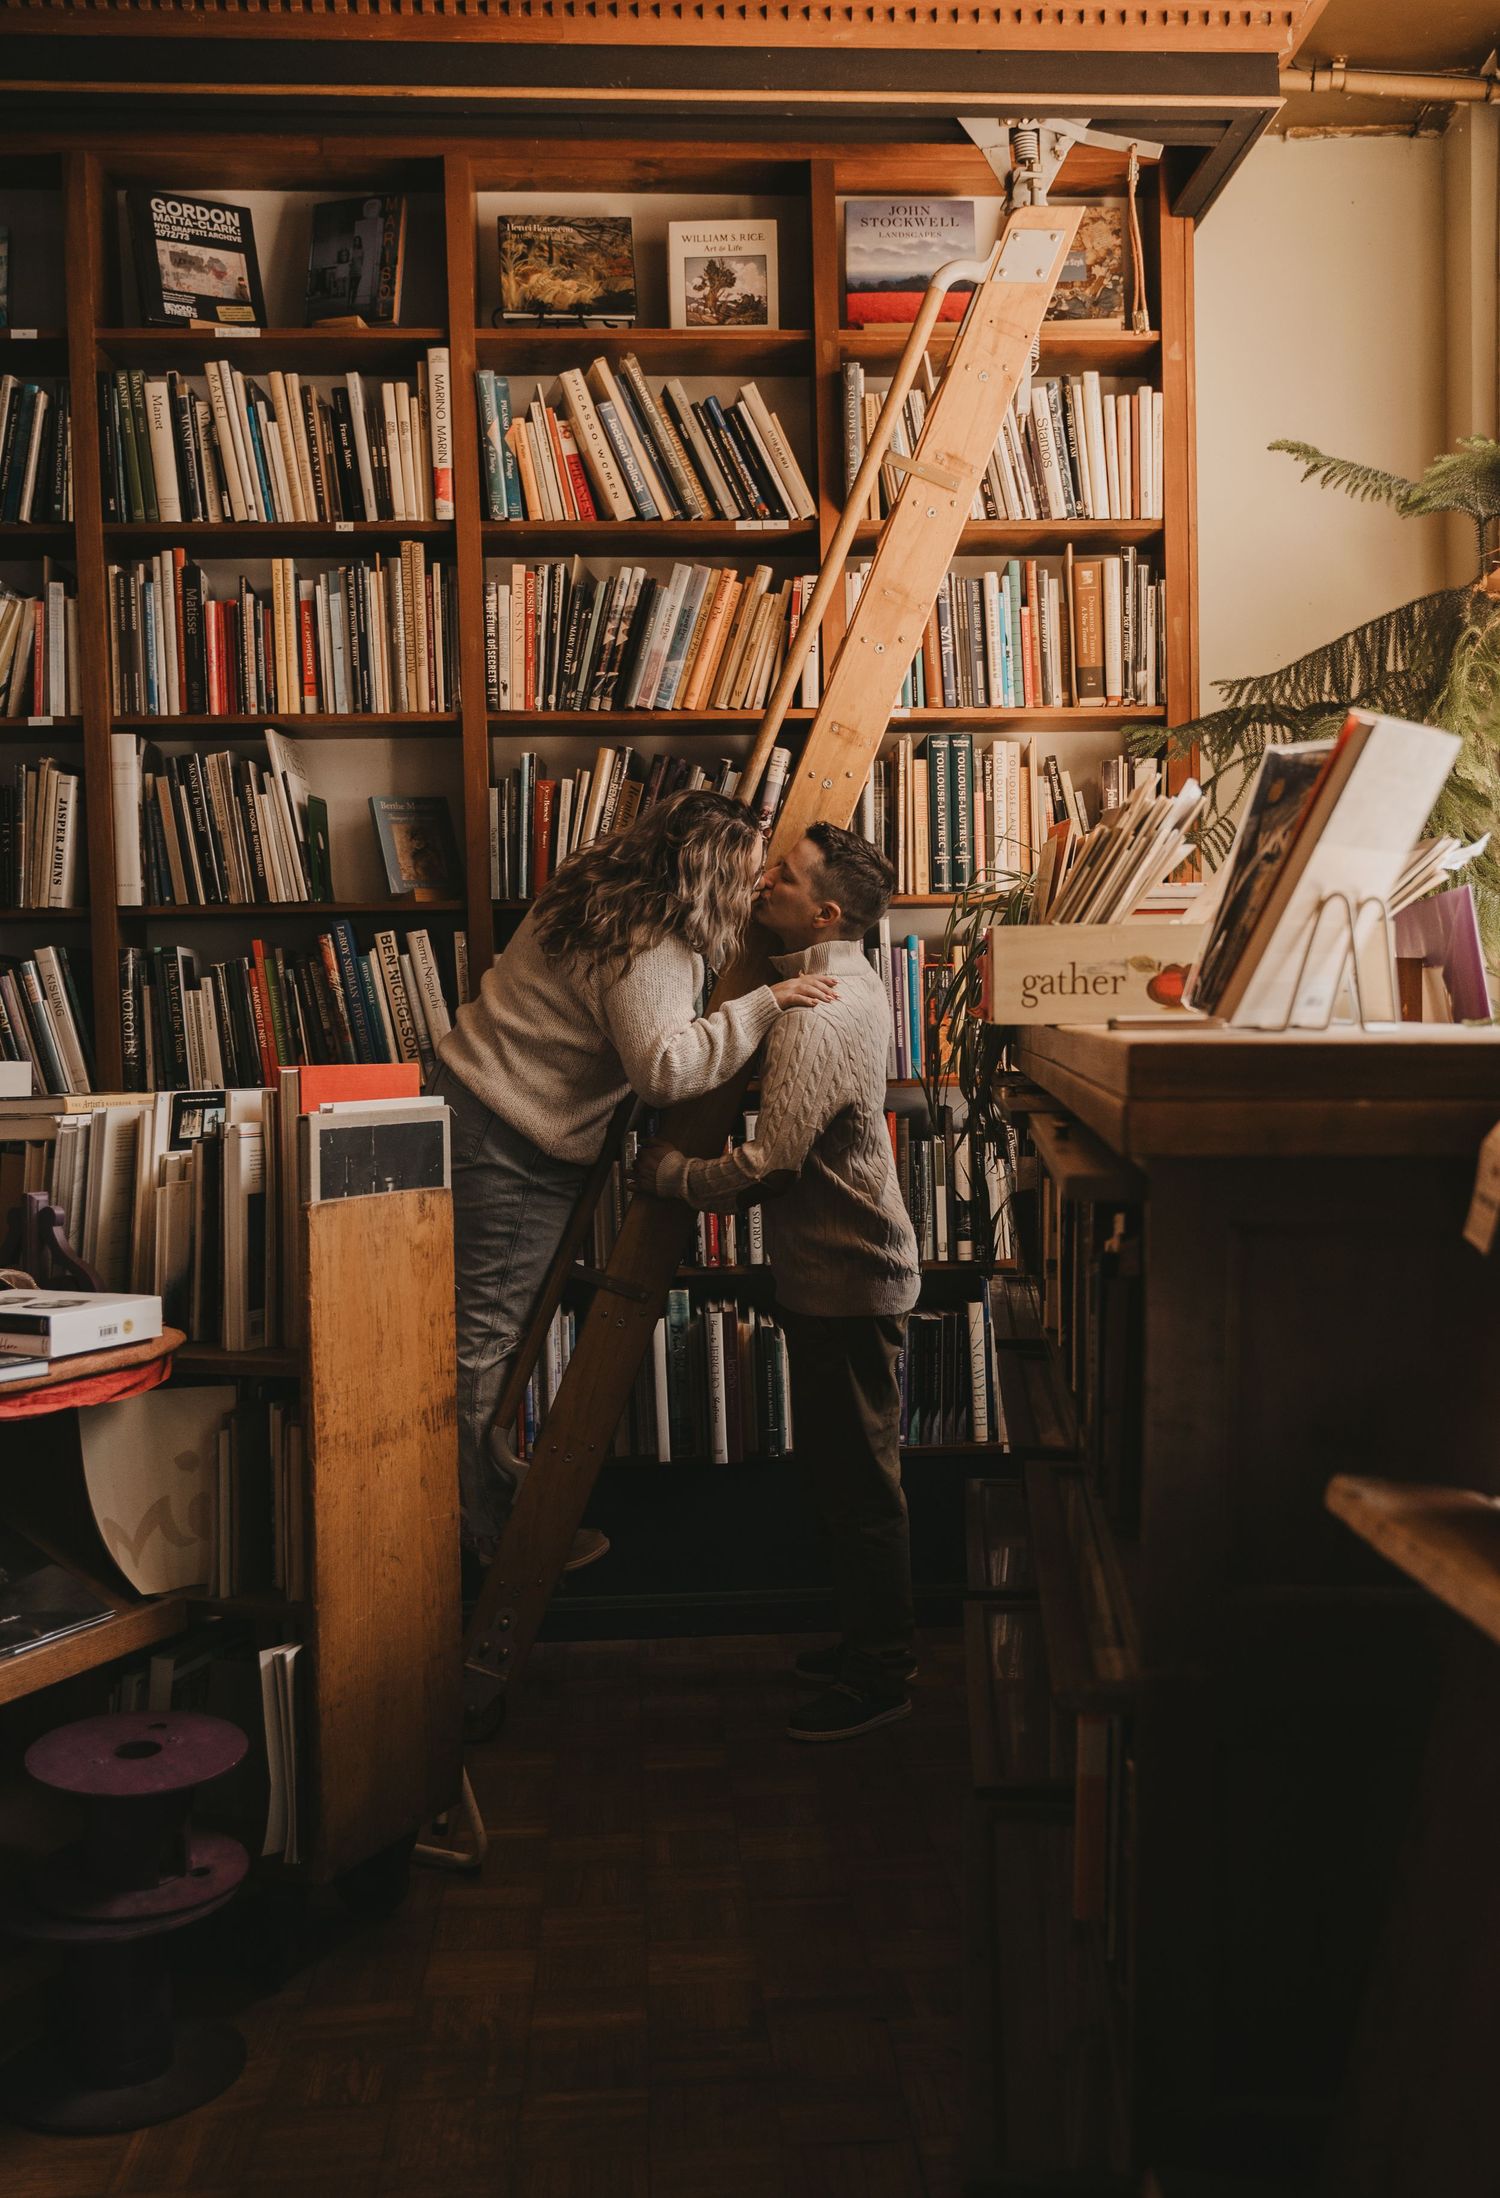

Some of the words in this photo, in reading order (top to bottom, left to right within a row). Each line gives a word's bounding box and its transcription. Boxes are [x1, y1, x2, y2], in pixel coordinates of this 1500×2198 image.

[150, 197, 241, 228] GORDON
[151, 212, 242, 235] MATTA-CLARK:
[860, 216, 960, 229] STOCKWELL
[888, 205, 931, 217] JOHN
[154, 229, 191, 242] 1972/73
[171, 225, 208, 238] GRAFFITI
[206, 231, 243, 244] ARCHIVE
[506, 223, 531, 233] Henri
[532, 223, 574, 234] Rousseau
[681, 234, 728, 244] WILLIAM
[740, 233, 765, 242] RICE
[878, 231, 943, 239] LANDSCAPES
[377, 196, 399, 317] MARISOL
[703, 244, 717, 253] Art
[727, 244, 743, 252] Life
[118, 375, 129, 409] MANET
[131, 375, 143, 409] MANET
[210, 374, 226, 420] MANET
[434, 374, 447, 420] MARINO
[631, 366, 656, 414] PISSARRO
[151, 393, 165, 431] Manet
[483, 393, 493, 425] PICASSO
[846, 384, 857, 440] SIMONDS
[181, 414, 192, 450] MANET
[339, 423, 349, 447] Franz
[436, 425, 448, 464] MARINI
[500, 400, 509, 430] PICASSO
[505, 457, 514, 480] Things
[642, 433, 658, 462] Pollock
[1036, 417, 1054, 469] Stamos
[343, 449, 353, 470] Marc
[487, 452, 497, 474] Things
[608, 417, 629, 457] Jackson
[624, 457, 644, 493] Pollock
[569, 461, 592, 519] PIRANESI
[597, 449, 620, 500] WOMEN
[403, 542, 412, 591] PEINTURES
[414, 545, 423, 599] MICHELANGELO
[416, 600, 423, 611] OF
[971, 581, 980, 602] SOPHIE
[185, 587, 199, 635] Matisse
[514, 582, 523, 643] POUSSIN
[665, 604, 676, 627] Howard
[684, 605, 694, 628] Howard
[973, 604, 982, 642] TAEUBER-ARP
[1088, 595, 1096, 632] DOMENICO
[1123, 616, 1131, 628] Bob
[417, 612, 425, 655] SCULPTURES
[487, 639, 497, 650] OF
[567, 625, 577, 647] MARY
[662, 628, 672, 641] Pyle
[679, 628, 689, 642] Pyle
[940, 625, 953, 655] SZYK
[1088, 634, 1097, 664] TIEPOLO
[351, 635, 359, 666] MERRIAM
[563, 648, 574, 674] PRATT
[488, 650, 498, 684] SECRETS
[188, 762, 199, 795] MONET
[210, 762, 219, 786] HOMAGE
[1048, 760, 1057, 775] John
[192, 797, 201, 805] by
[215, 788, 220, 796] TO
[244, 784, 253, 805] HENRY
[936, 751, 947, 848] TOULOUSE-LAUTREC
[957, 750, 967, 848] TOULOUSE-LAUTREC
[1051, 775, 1062, 801] Trumbull
[1105, 788, 1117, 810] John
[56, 797, 68, 843] JASPER
[195, 807, 207, 833] himself
[216, 798, 225, 814] HENRY
[248, 808, 257, 832] MOORE
[600, 783, 619, 834] REMBRANDT
[220, 818, 228, 839] MOORE
[52, 845, 63, 886] JOHNS
[252, 834, 265, 877] REMEMBERED
[380, 934, 397, 966] BEN
[167, 960, 179, 981] The
[362, 961, 370, 982] ARTIST
[415, 935, 428, 965] Isamu
[424, 966, 441, 1010] Noguchi
[1021, 961, 1126, 1010] gather
[46, 973, 65, 1017] KISLING
[170, 983, 180, 1000] Art
[251, 986, 262, 1019] MAKING
[255, 957, 266, 993] HARLAND
[261, 994, 270, 1022] MILLER
[266, 1031, 274, 1049] XXX
[271, 985, 283, 1029] Elizabeth
[344, 957, 360, 998] NEIMAN
[352, 1003, 365, 1026] FIVE
[122, 988, 135, 1056] MOROLES
[172, 1002, 180, 1013] of
[172, 1015, 182, 1031] the
[387, 969, 419, 1059] NICHOLSON
[256, 1019, 264, 1028] IT
[257, 1029, 267, 1048] NEW
[175, 1034, 185, 1063] Peales
[276, 1033, 288, 1066] Murray
[751, 1211, 762, 1250] CARLOS
[710, 1345, 720, 1389] JERICHO
